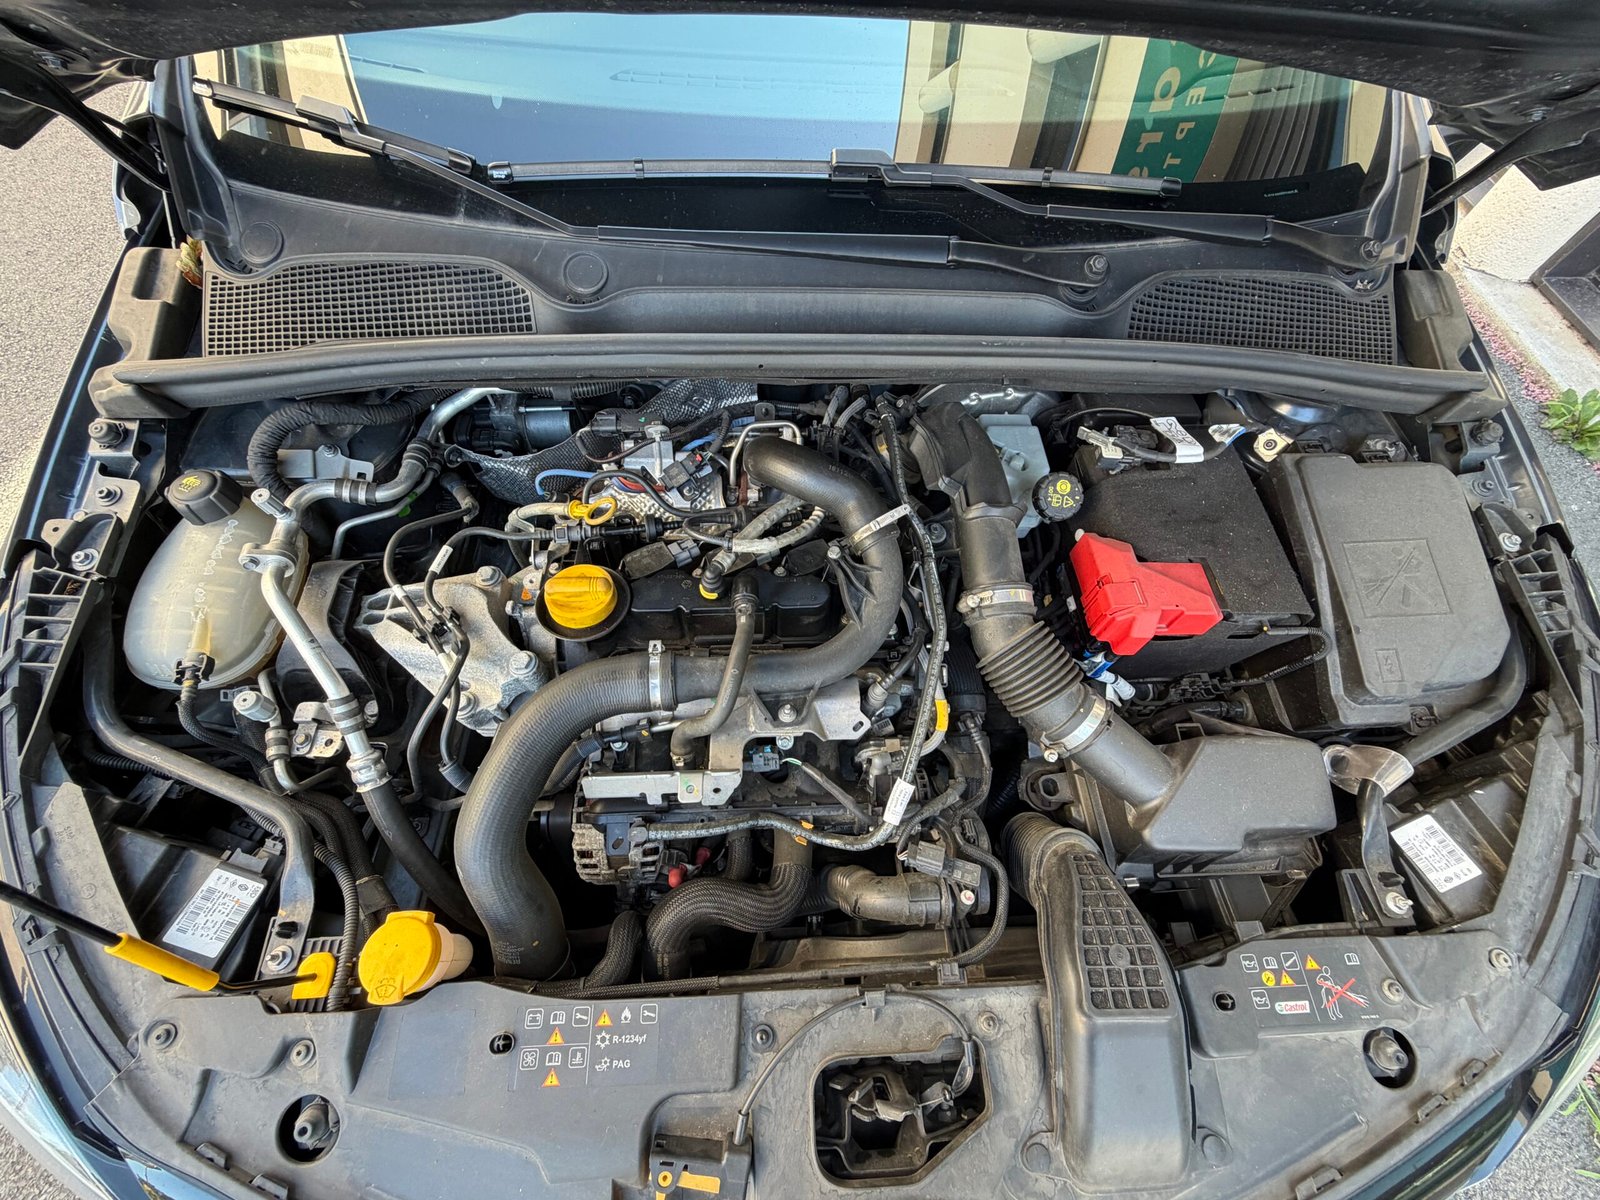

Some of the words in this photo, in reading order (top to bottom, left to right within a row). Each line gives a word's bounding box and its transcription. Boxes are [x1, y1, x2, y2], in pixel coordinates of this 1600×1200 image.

[1284, 1002, 1308, 1012] Castrol
[612, 1033, 647, 1044] R-1234yf
[612, 1059, 631, 1069] PAG
